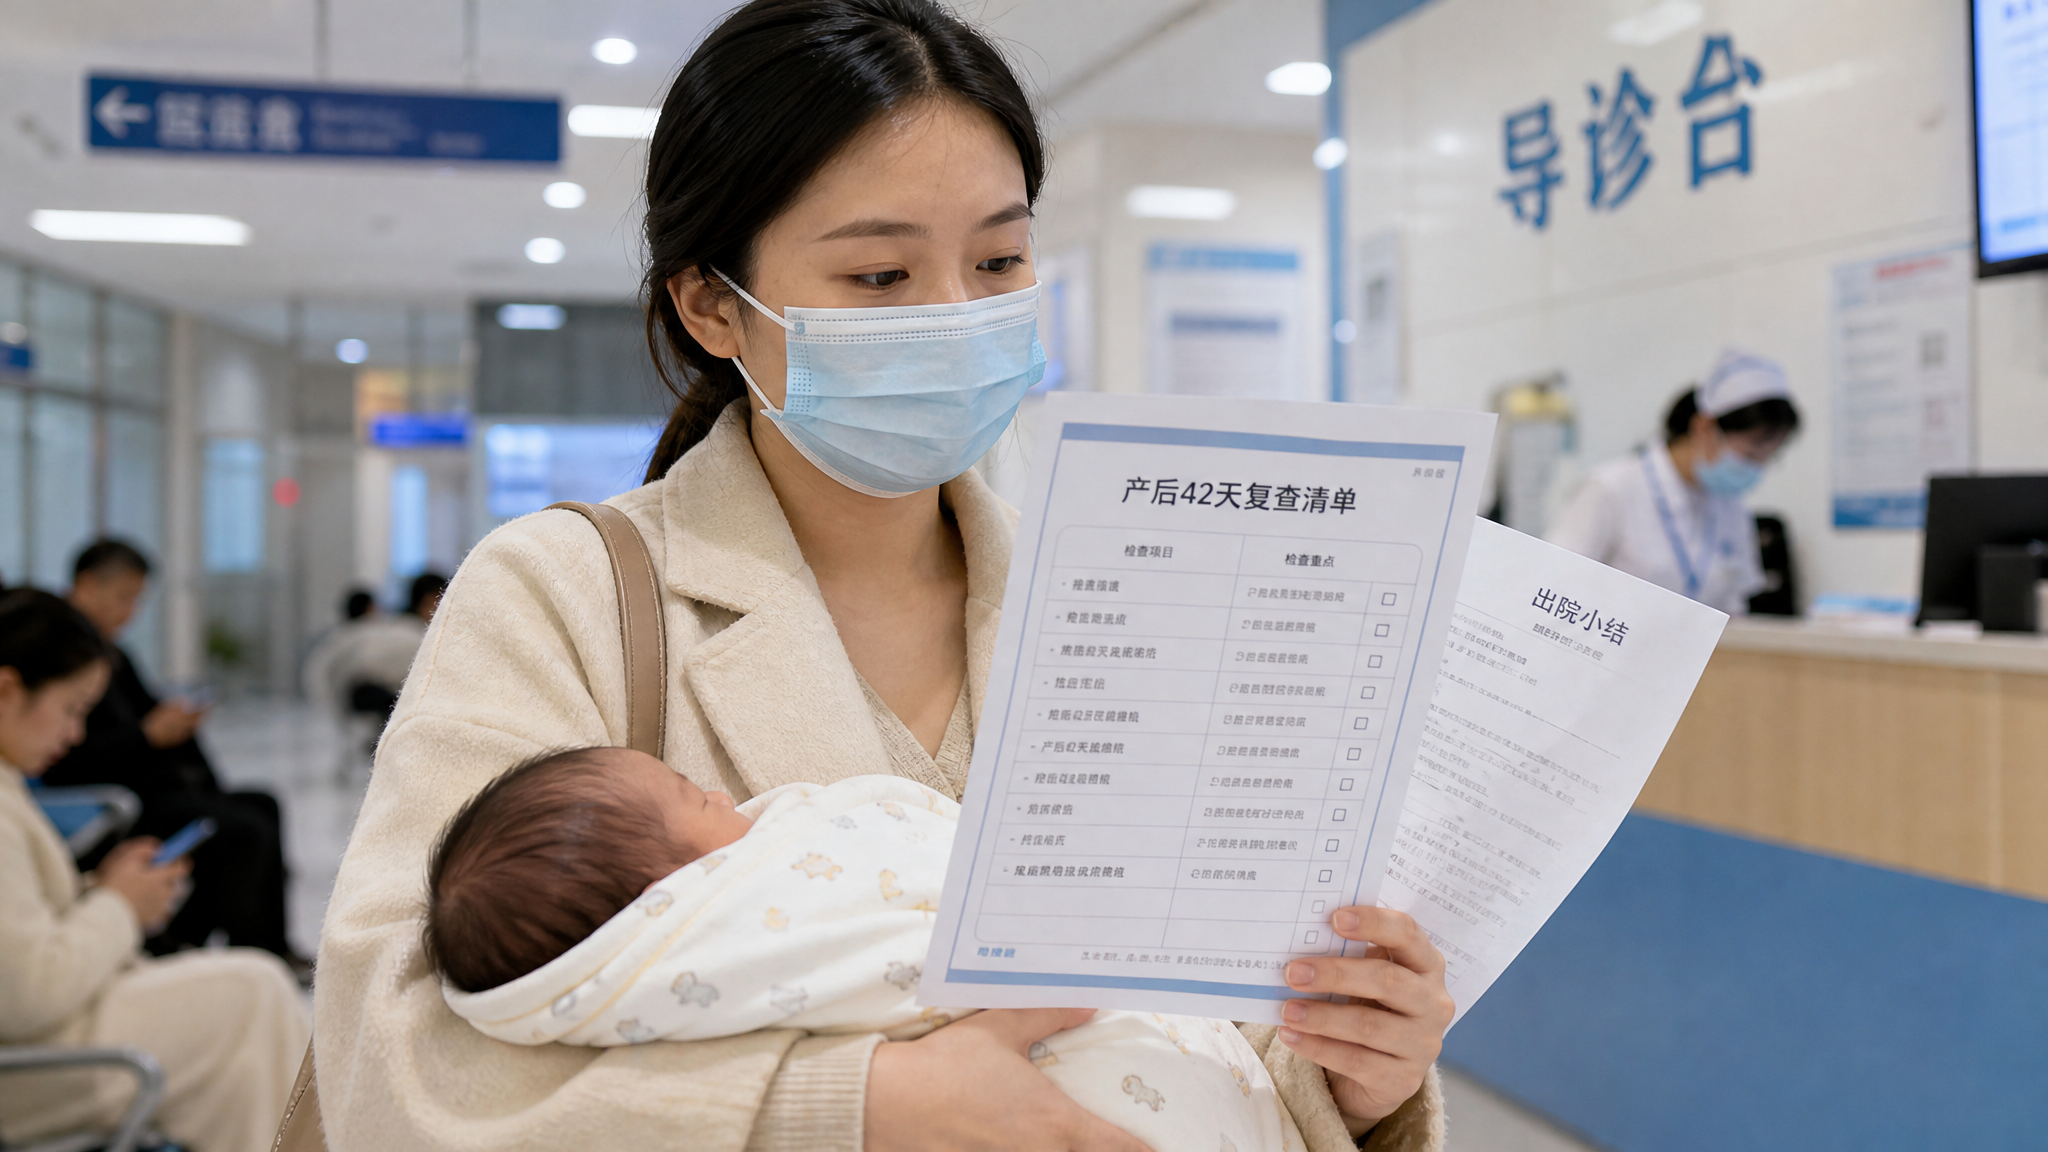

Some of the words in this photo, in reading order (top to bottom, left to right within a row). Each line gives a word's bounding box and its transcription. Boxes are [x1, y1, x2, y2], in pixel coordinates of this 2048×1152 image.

[1497, 34, 1764, 231] 导诊台
[1122, 476, 1356, 515] 产后42天复查清单
[1123, 544, 1174, 560] 检查项目
[1284, 552, 1335, 569] 检查重点
[1531, 586, 1630, 647] 出院小结
